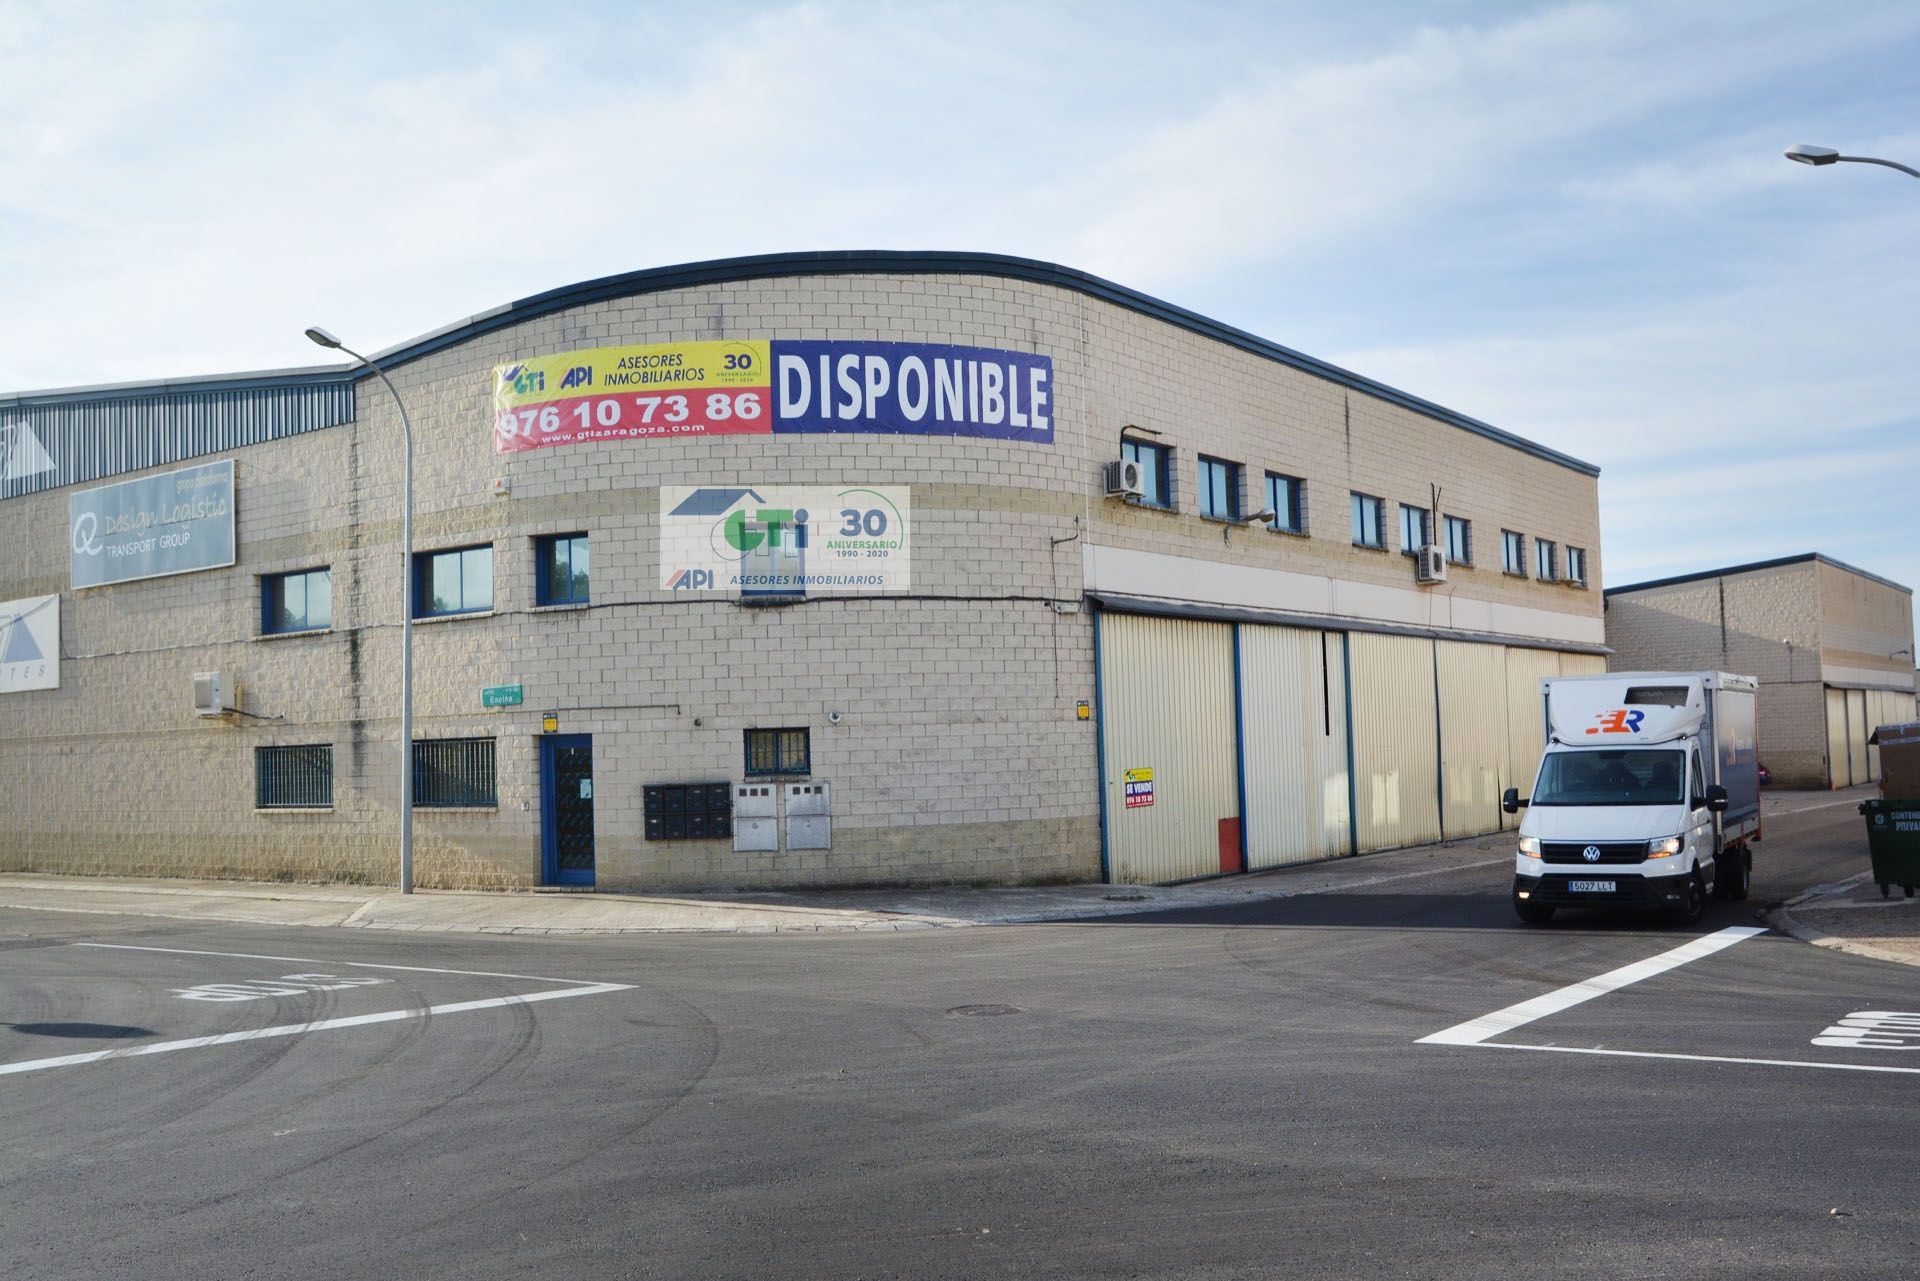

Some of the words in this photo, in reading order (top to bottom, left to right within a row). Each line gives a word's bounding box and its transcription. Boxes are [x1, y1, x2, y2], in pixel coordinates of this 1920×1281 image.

[617, 353, 683, 370] ASESORES
[723, 354, 752, 370] 30
[560, 365, 592, 390] API
[604, 368, 705, 387] INMOBILIARIOS
[778, 353, 1049, 430] DISPONIBLE
[500, 406, 560, 440] 976
[573, 399, 621, 429] 10
[636, 395, 689, 424] 73
[705, 393, 761, 421] 86
[541, 424, 705, 444] www.gtizaragoza.com
[106, 537, 156, 559] TRANSPORT
[159, 532, 190, 549] GROUP
[1574, 882, 1595, 891] 5027
